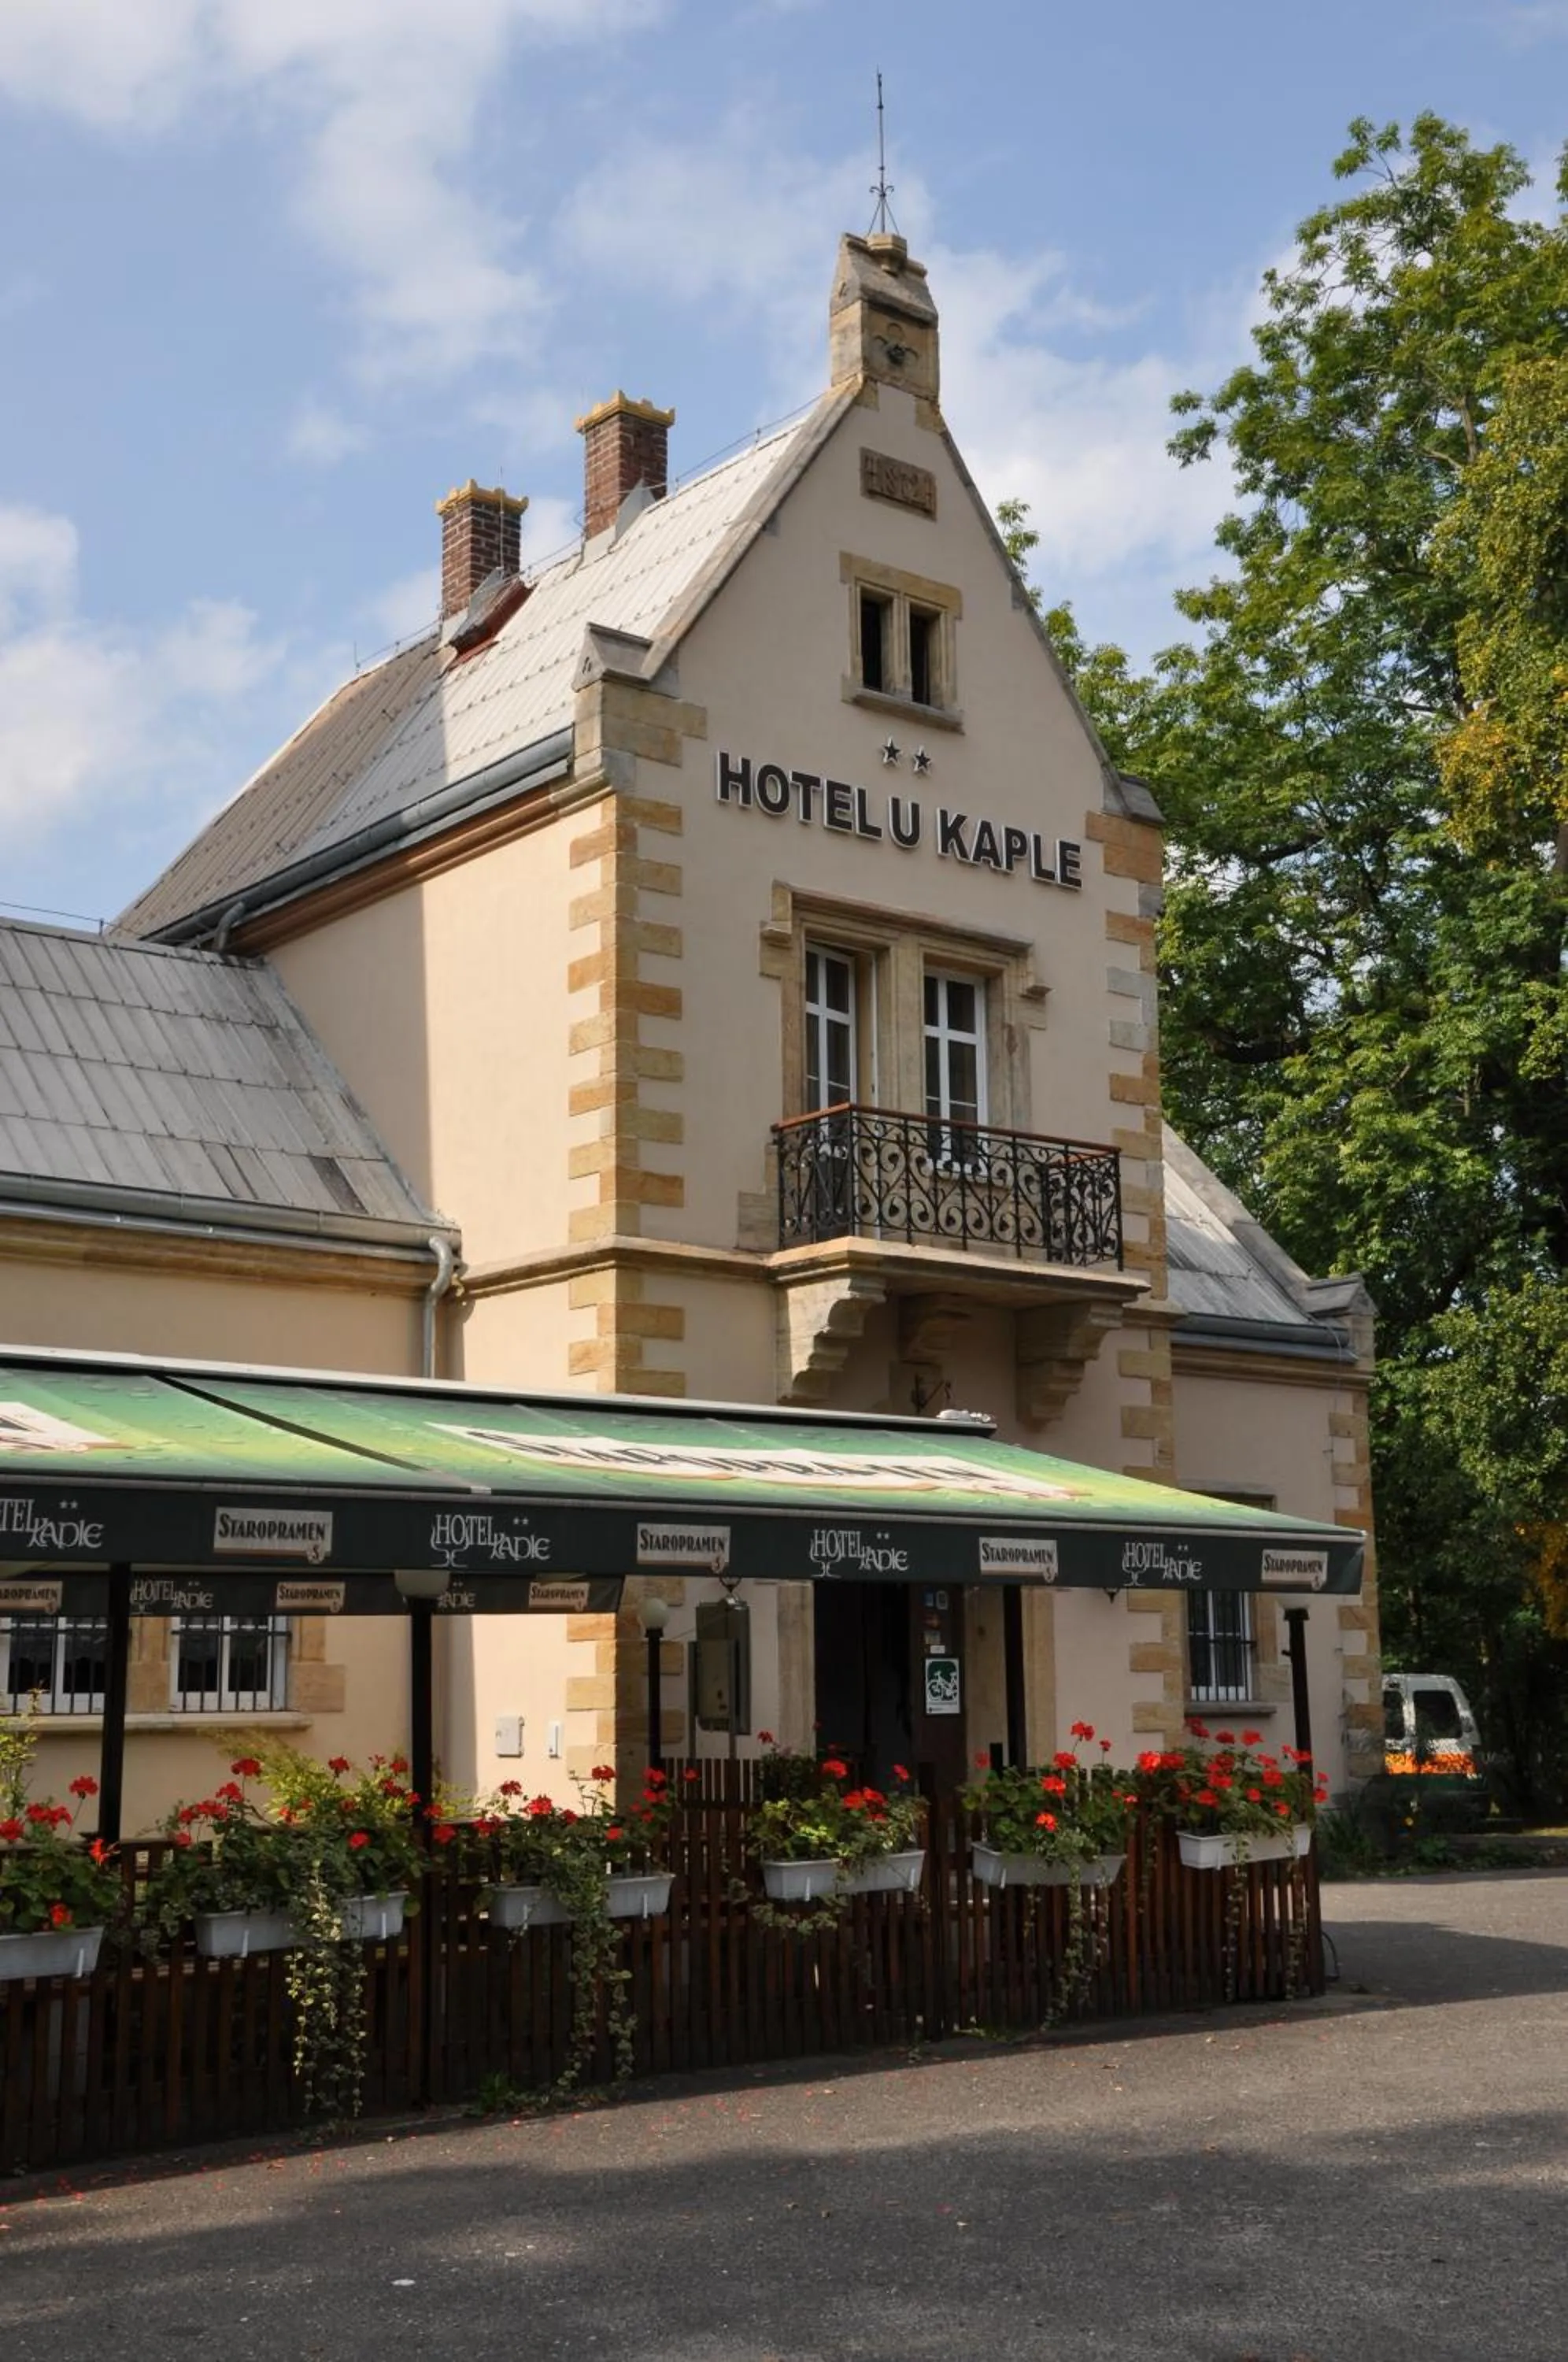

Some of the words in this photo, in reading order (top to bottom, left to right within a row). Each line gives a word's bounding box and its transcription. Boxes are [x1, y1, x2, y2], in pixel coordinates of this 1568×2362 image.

[716, 750, 882, 841] HOTEL
[888, 795, 922, 850] U
[936, 807, 1083, 890] KAPLE
[0, 1498, 36, 1532] TEL
[218, 1512, 327, 1542] STAROPRAMEN
[435, 1514, 495, 1546] HOTEL
[640, 1528, 726, 1553] STAROPRAMEN
[813, 1529, 864, 1558] HOTEL
[982, 1542, 1054, 1565] STAROPRAMEN
[1125, 1542, 1167, 1569] HOTEL
